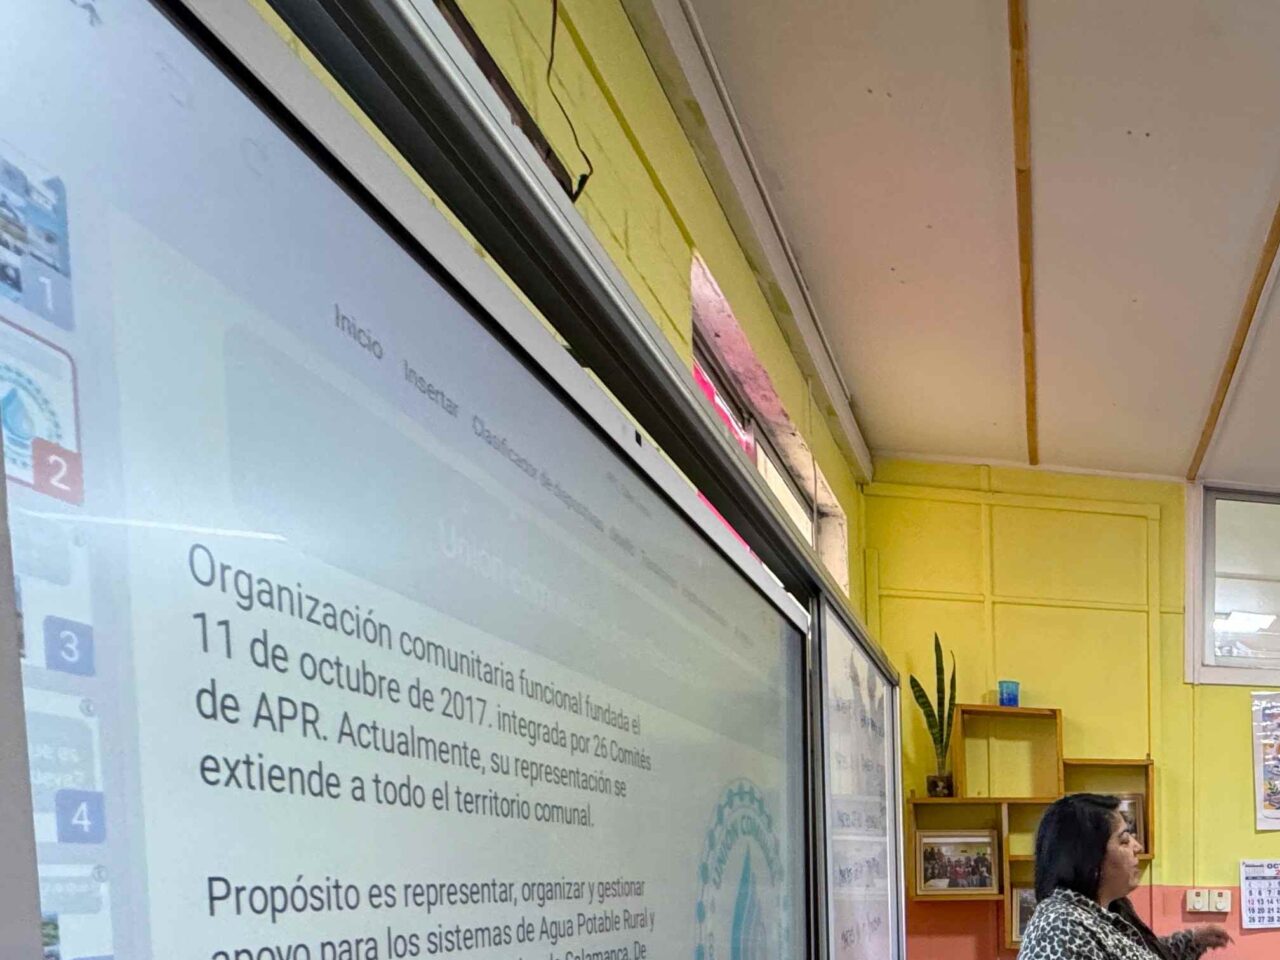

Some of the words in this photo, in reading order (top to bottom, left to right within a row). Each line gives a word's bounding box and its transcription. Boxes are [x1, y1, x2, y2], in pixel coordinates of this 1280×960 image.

[38, 275, 54, 313] 1
[334, 303, 383, 360] Inicio
[403, 359, 459, 418] Insertar
[47, 454, 71, 491] 2
[59, 630, 80, 662] 3
[189, 543, 392, 650] Organización
[399, 630, 515, 692] comunitaria
[519, 669, 582, 715] funcional
[585, 695, 629, 732] fundada
[631, 714, 641, 736] el
[193, 612, 232, 659] 11
[249, 629, 289, 674] de
[300, 652, 401, 704] octubre
[408, 677, 434, 712] de
[441, 687, 493, 728] 2017.
[497, 704, 567, 746] integrada
[571, 732, 590, 756] por
[594, 734, 608, 758] 26
[610, 740, 652, 771] Comités
[196, 678, 240, 724] de
[253, 692, 328, 741] APR.
[338, 711, 485, 775] Actualmente,
[490, 751, 510, 776] su
[514, 757, 612, 794] representación
[614, 777, 627, 797] se
[200, 752, 341, 799] extiende
[351, 776, 366, 802] a
[372, 773, 426, 808] todo
[432, 780, 450, 811] el
[455, 785, 530, 821] territorio
[534, 802, 595, 827] comunal.
[71, 802, 92, 833] 4
[207, 874, 360, 924] Propósito
[368, 883, 397, 909] es
[404, 879, 517, 914] representar,
[521, 877, 585, 907] organizar
[587, 879, 595, 905] y
[597, 876, 645, 903] gestionar
[387, 926, 420, 960] los
[427, 923, 512, 954] sistemas
[516, 916, 535, 943] de
[539, 915, 574, 945] Agua
[577, 910, 620, 936] Potable
[623, 906, 647, 929] Rural
[648, 910, 655, 932] y
